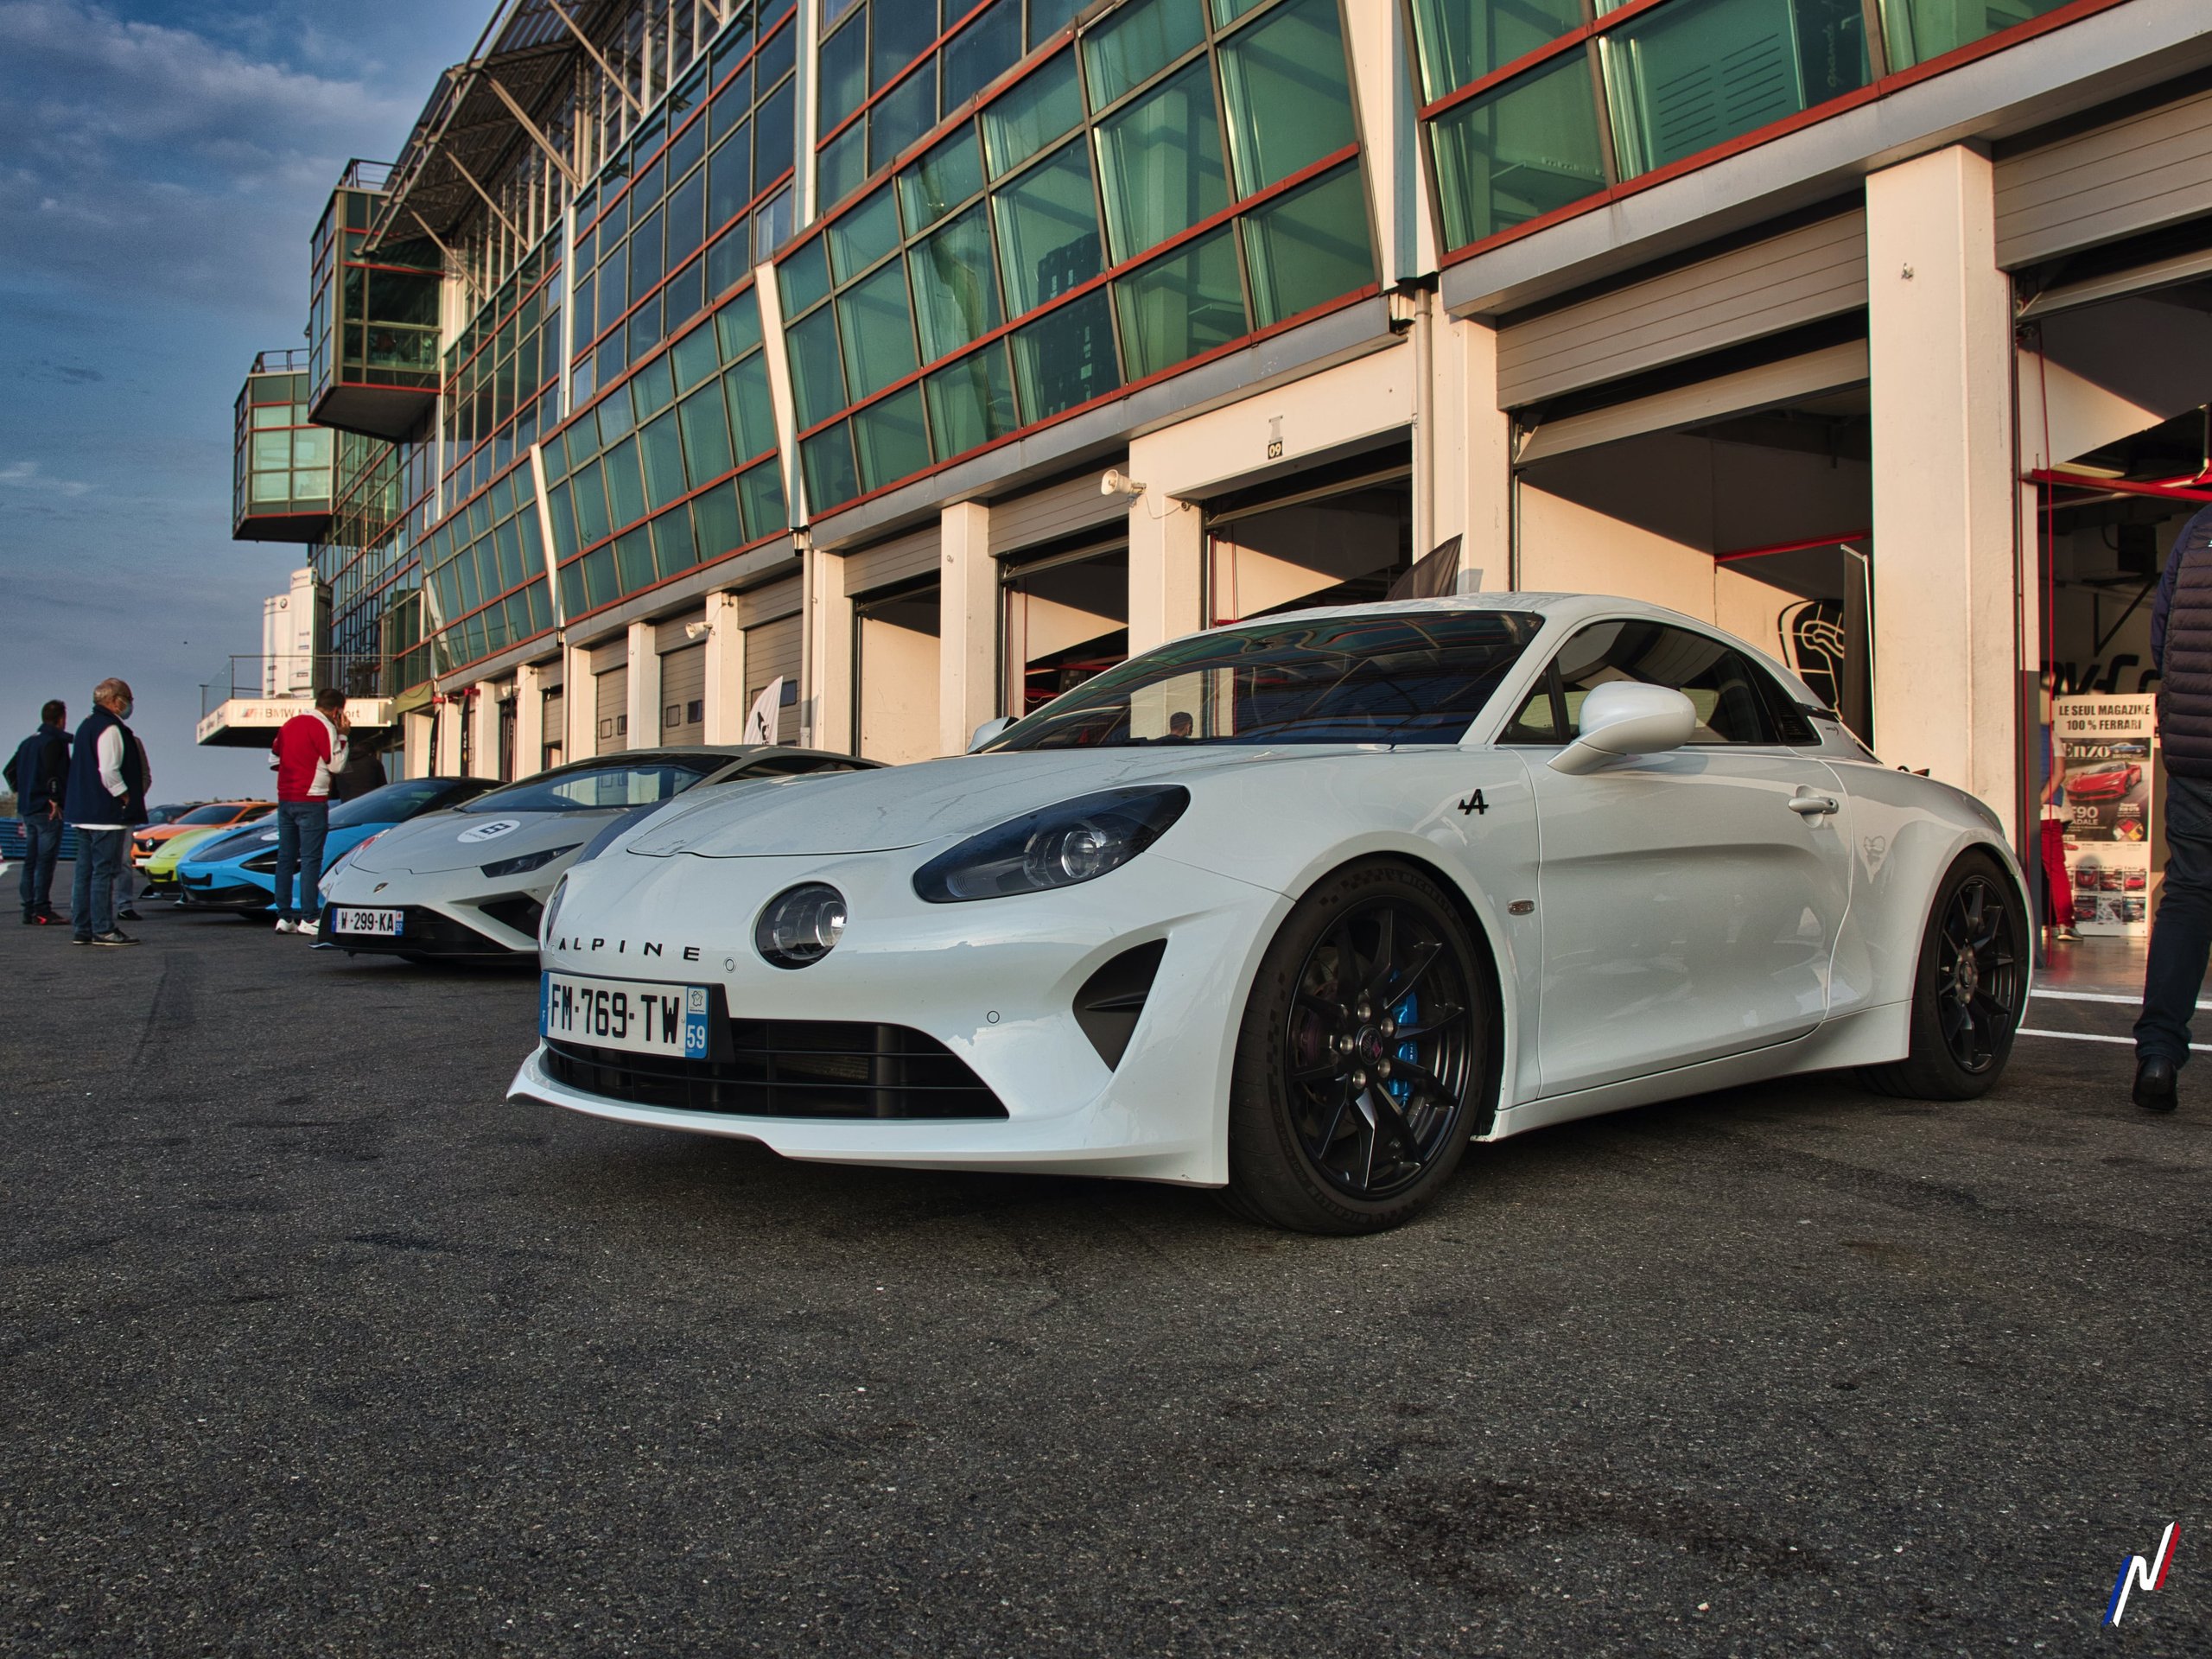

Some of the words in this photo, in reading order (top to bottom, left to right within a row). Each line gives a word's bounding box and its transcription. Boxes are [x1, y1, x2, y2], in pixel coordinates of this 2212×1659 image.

[1269, 442, 1281, 458] 09
[265, 709, 294, 718] BMW
[2059, 705, 2069, 715] LE
[2072, 705, 2095, 715] SEUL
[2098, 704, 2150, 715] MAGAZINE
[2067, 720, 2086, 730] 100
[2088, 720, 2097, 730] %
[2099, 720, 2141, 730] FERRARI
[2063, 742, 2111, 758] Enzo
[558, 938, 700, 962] ALPINE
[551, 983, 680, 1044] FM-769-TW
[686, 1025, 706, 1049] 59
